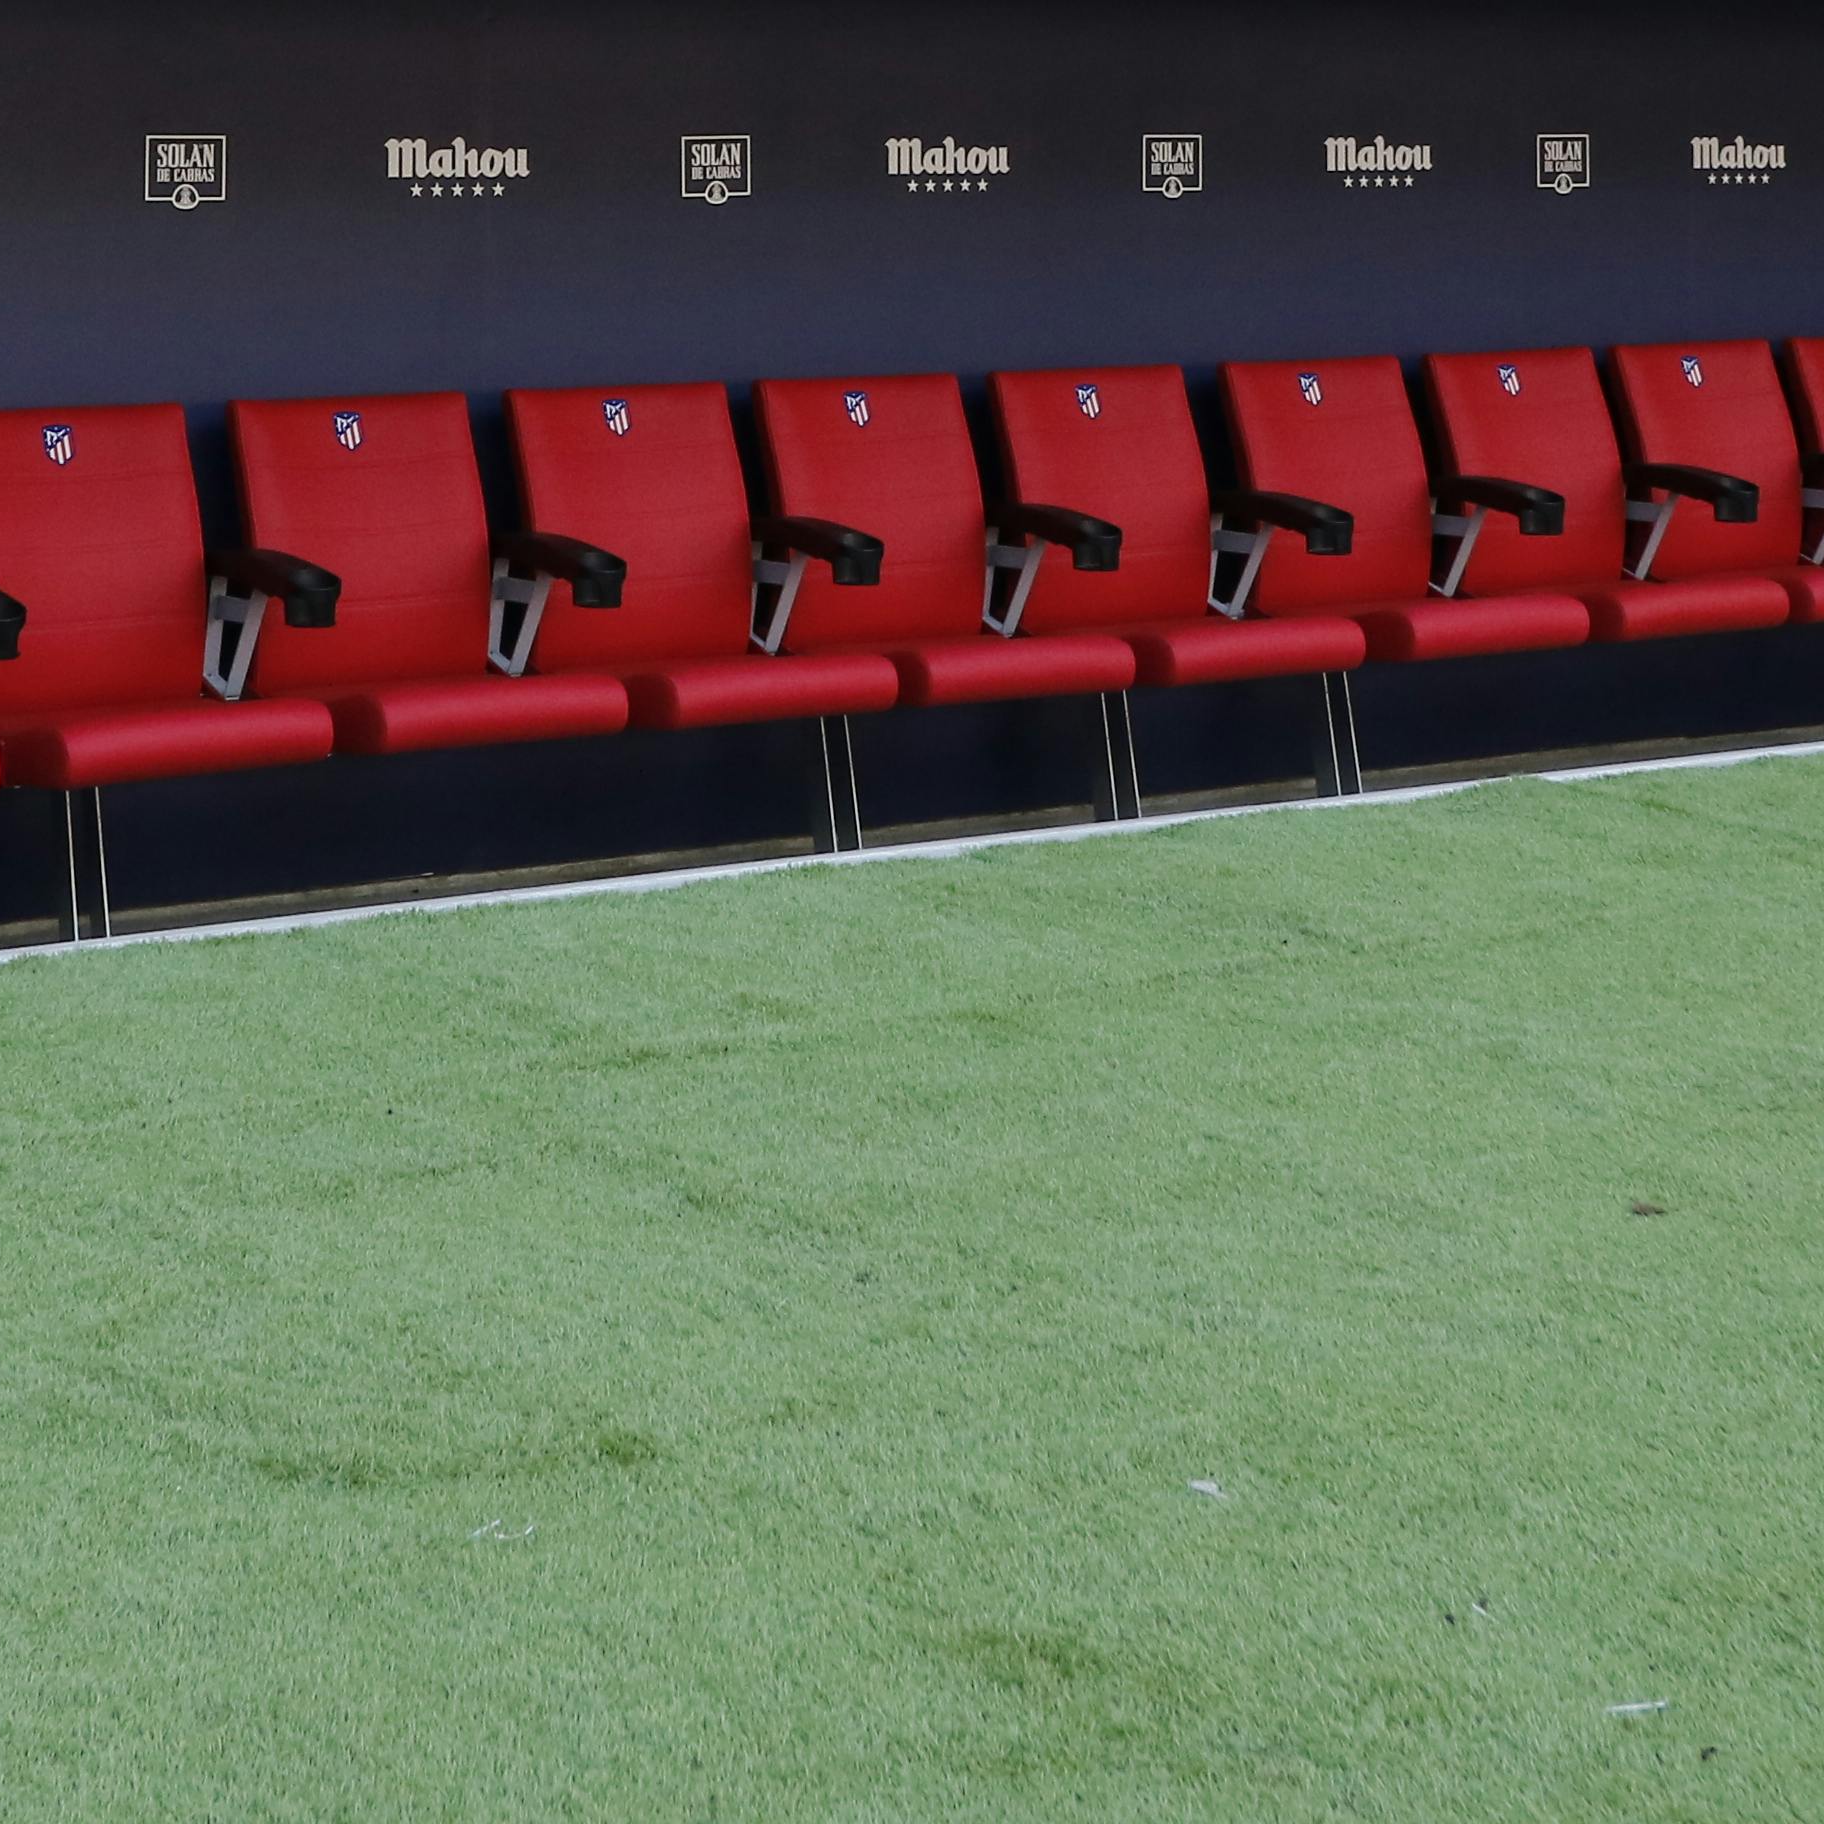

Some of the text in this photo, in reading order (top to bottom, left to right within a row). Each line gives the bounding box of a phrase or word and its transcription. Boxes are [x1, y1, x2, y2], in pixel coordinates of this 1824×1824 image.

[384, 137, 530, 178] Mahou
[885, 136, 1010, 175] Mahou
[1324, 136, 1432, 171] Mahou
[1691, 136, 1786, 169] Mahou
[157, 168, 214, 182] DE CABRAS
